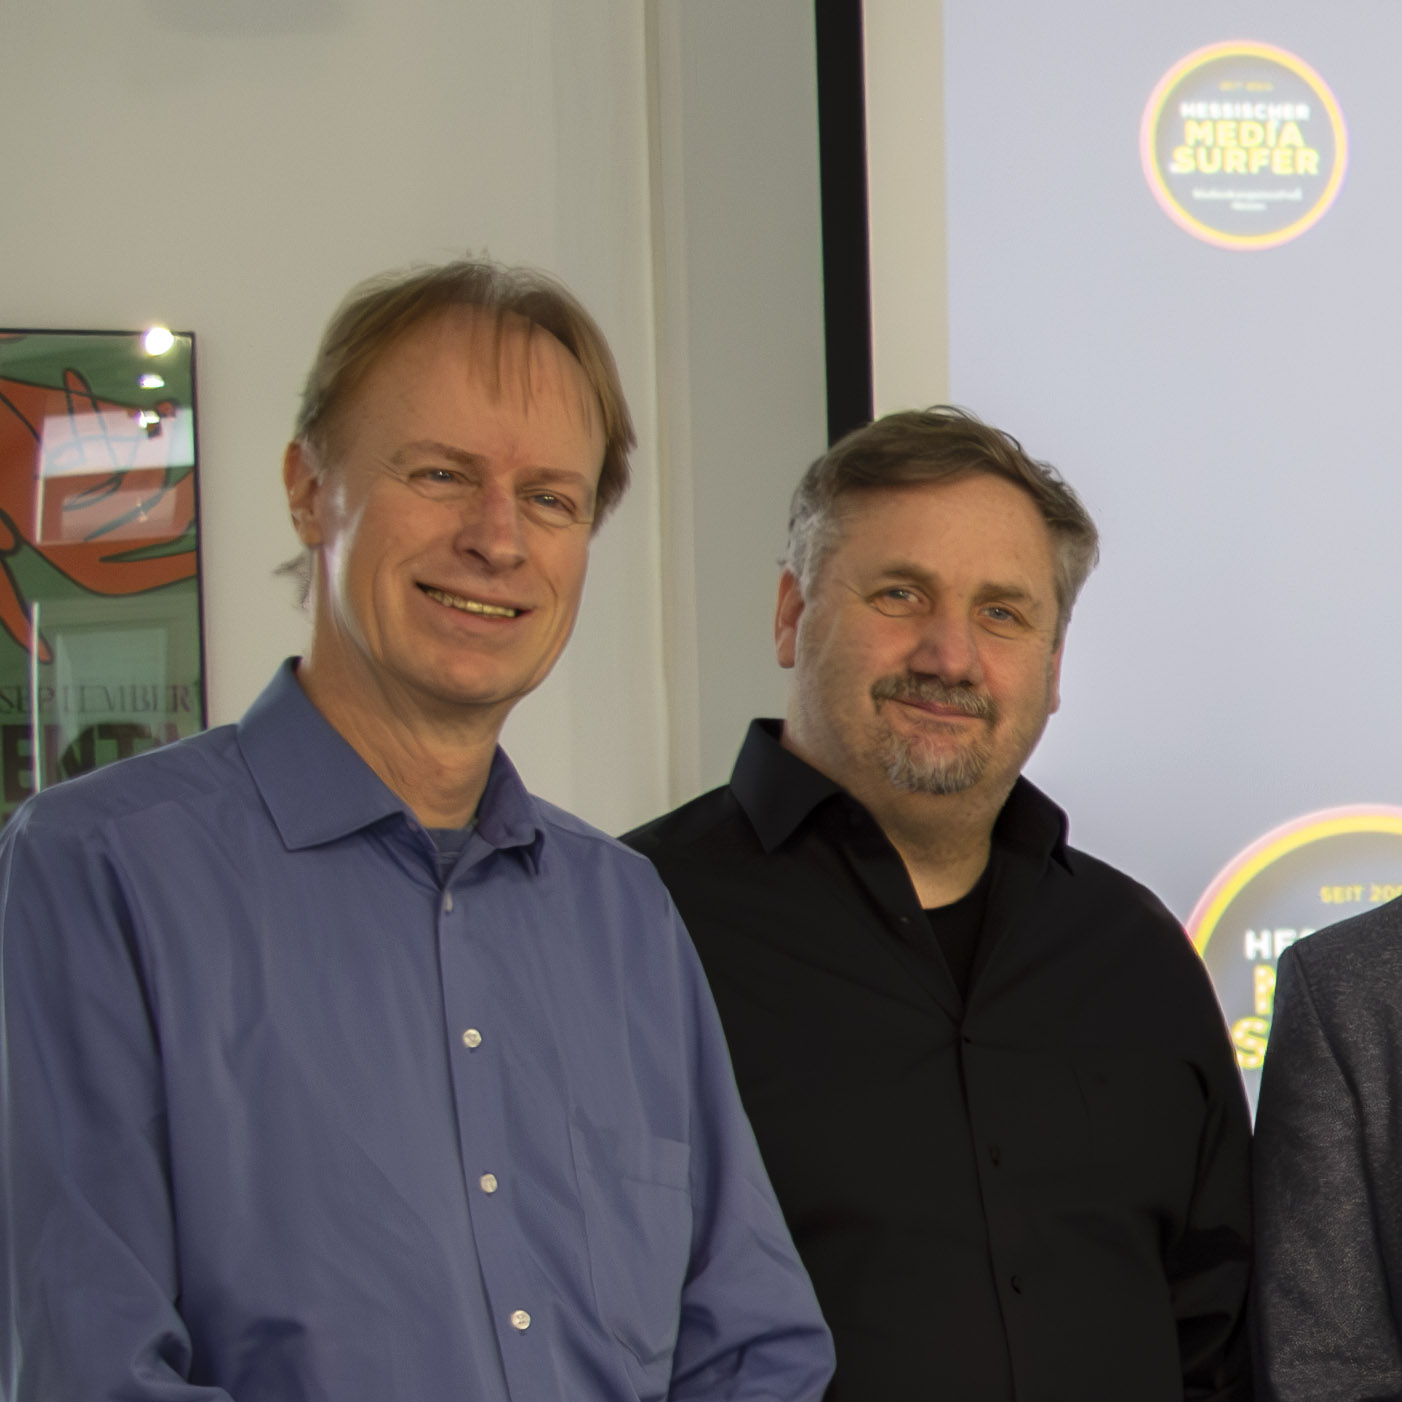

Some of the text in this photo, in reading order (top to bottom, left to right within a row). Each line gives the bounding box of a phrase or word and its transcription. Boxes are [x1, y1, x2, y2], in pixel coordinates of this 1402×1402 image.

[1179, 101, 1310, 120] HESSISCHER
[1184, 119, 1306, 147] MEDIA
[1172, 146, 1320, 175] SURFER
[1, 724, 181, 803] ENT
